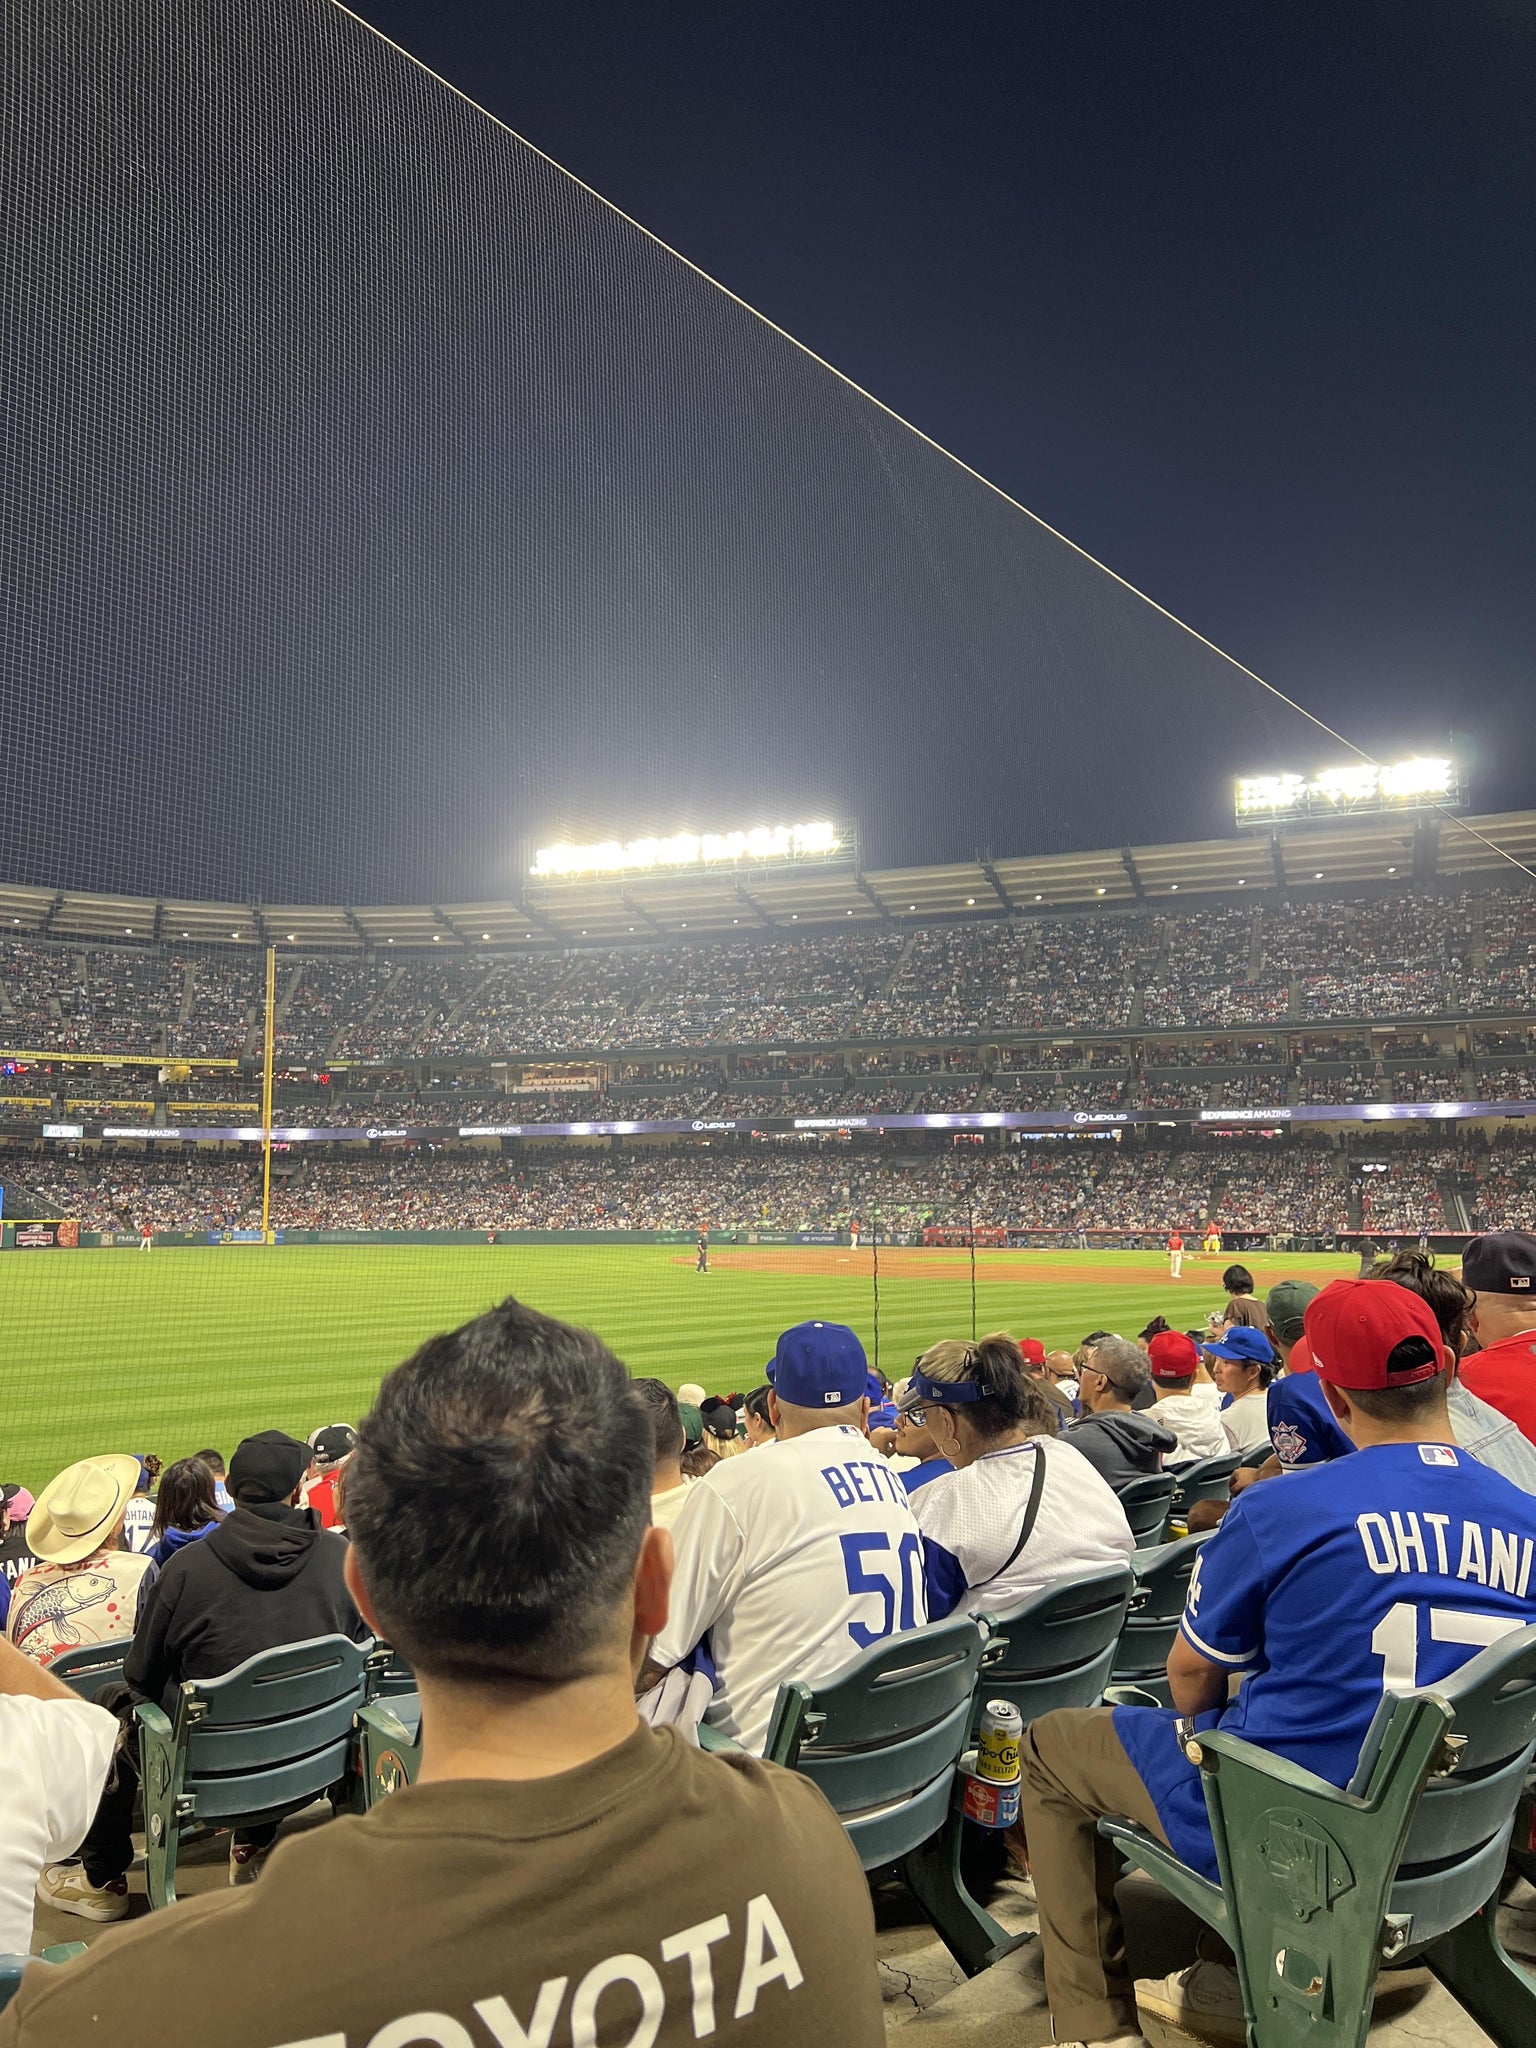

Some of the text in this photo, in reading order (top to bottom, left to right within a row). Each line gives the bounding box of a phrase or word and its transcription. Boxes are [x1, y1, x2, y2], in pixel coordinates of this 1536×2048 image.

[704, 1121, 736, 1129] LEXUS
[837, 1118, 868, 1127] AMAZING
[1254, 1109, 1292, 1119] AMAZING
[859, 1234, 882, 1244] Modlo
[820, 1461, 909, 1510] BETTS
[1356, 1511, 1535, 1599] OHTANI
[839, 1532, 928, 1650] 50
[262, 1893, 804, 2048] YOTA
